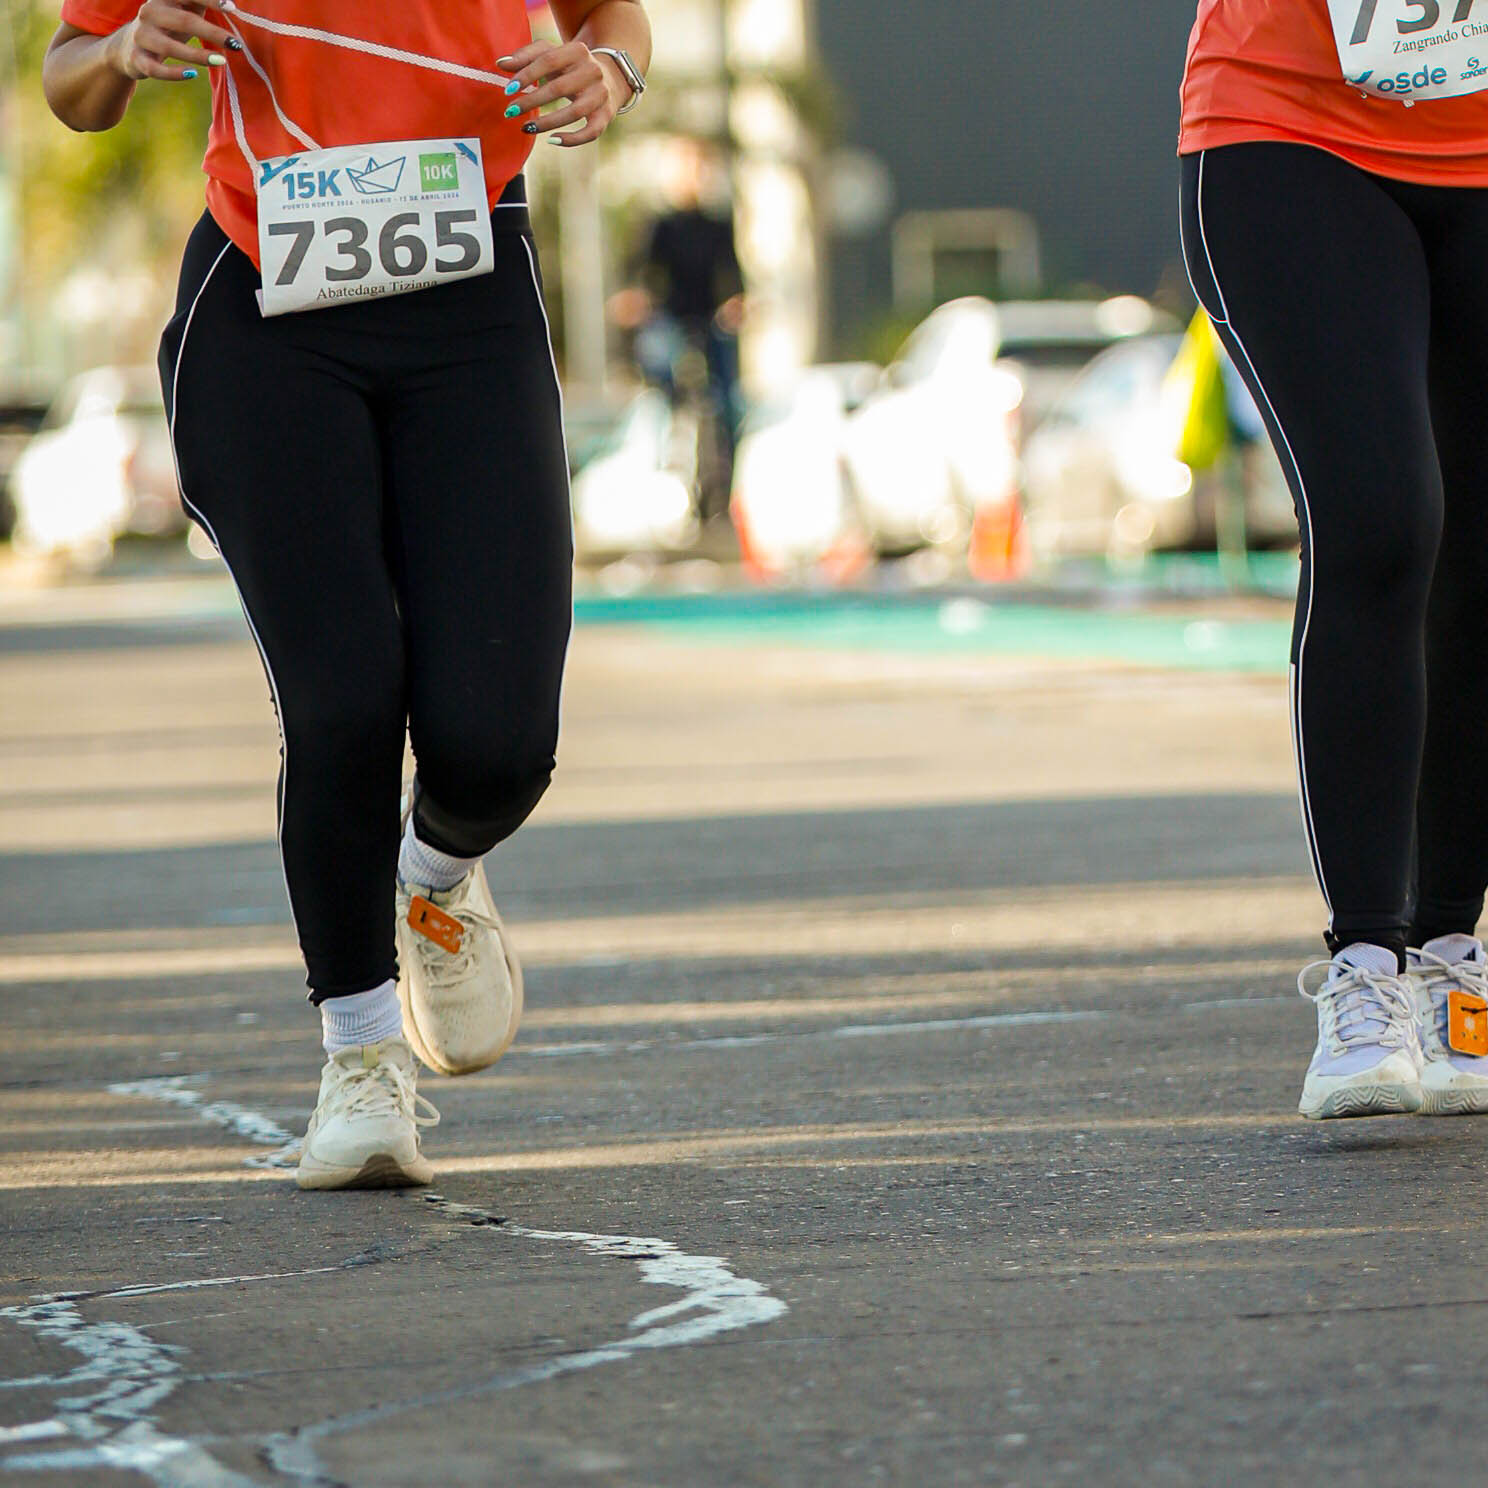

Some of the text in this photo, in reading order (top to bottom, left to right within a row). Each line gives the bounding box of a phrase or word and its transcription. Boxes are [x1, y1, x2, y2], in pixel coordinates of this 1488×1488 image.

[1393, 29, 1459, 54] Zangrando
[1377, 64, 1448, 93] osde
[282, 163, 454, 200] 15K 10K
[268, 209, 481, 286] 7365
[316, 279, 438, 300] Abatedaga Tiziana
